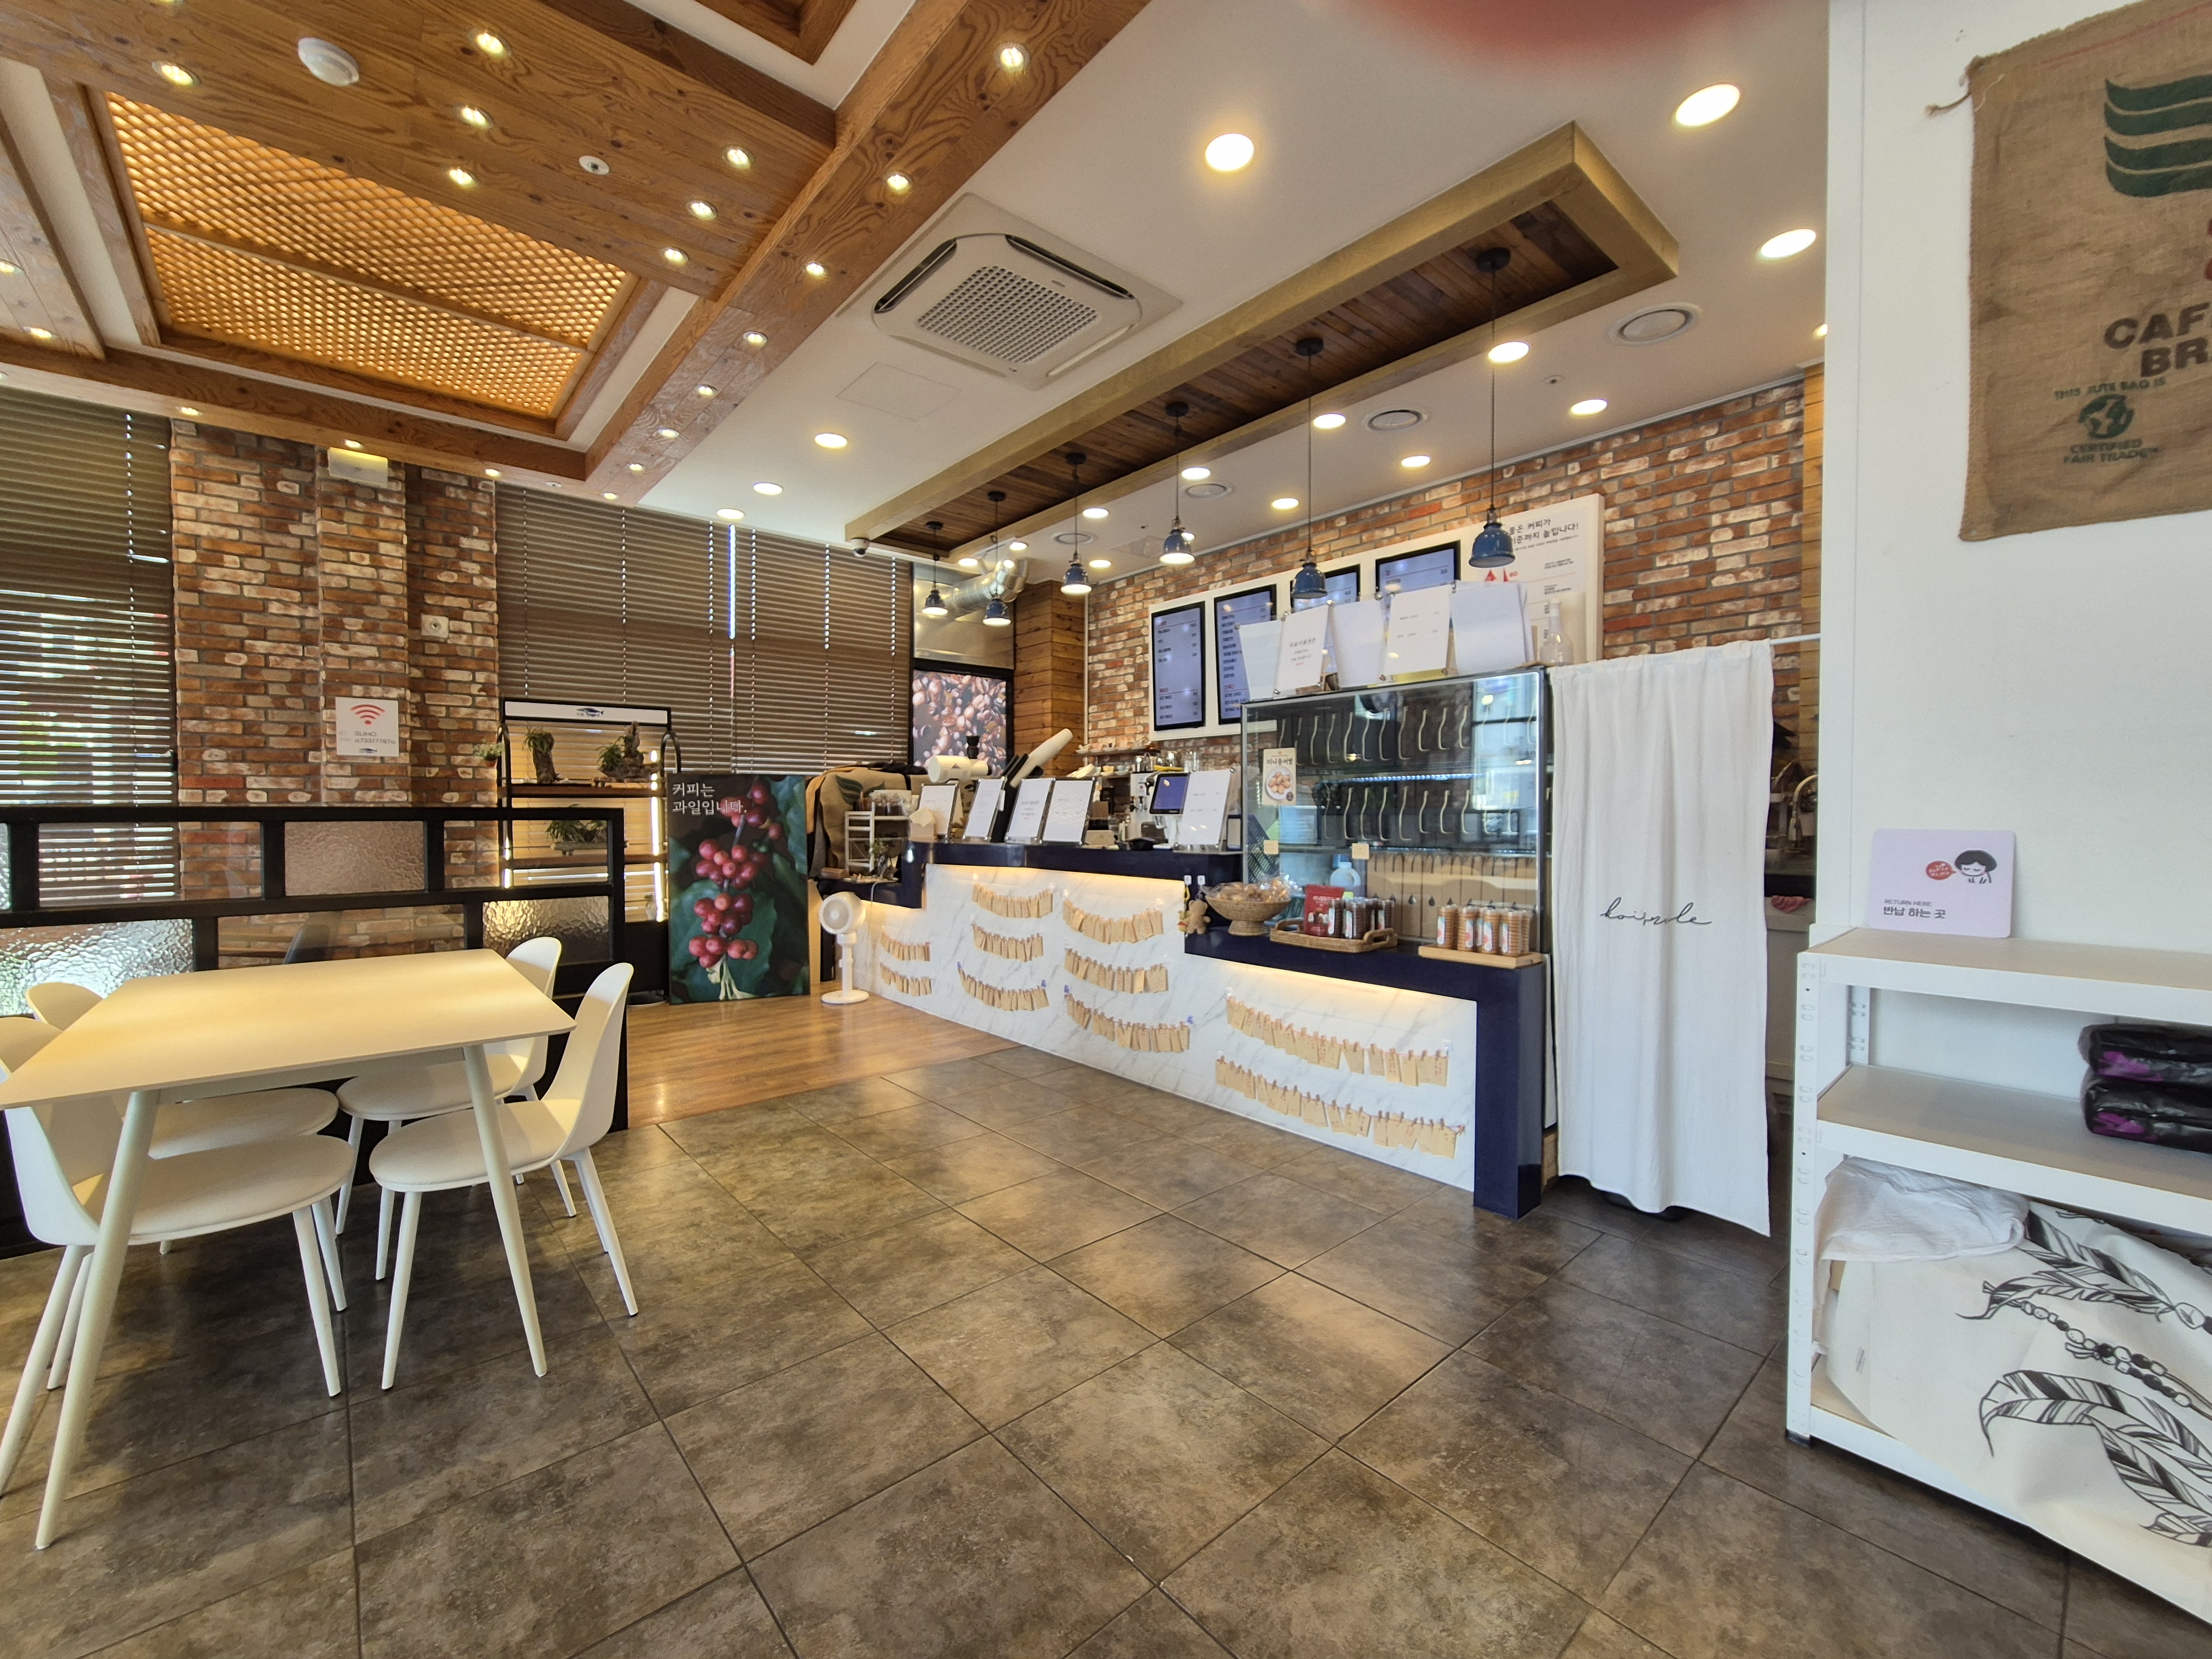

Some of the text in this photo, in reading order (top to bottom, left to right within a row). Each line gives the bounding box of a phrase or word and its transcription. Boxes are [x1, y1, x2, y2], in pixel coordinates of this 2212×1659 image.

[2104, 302, 2212, 349] CAF
[2140, 337, 2212, 378] BR
[672, 782, 715, 797] 커피는
[672, 800, 747, 816] 과일입니다.
[1884, 906, 1947, 919] 반납 하는 곳
